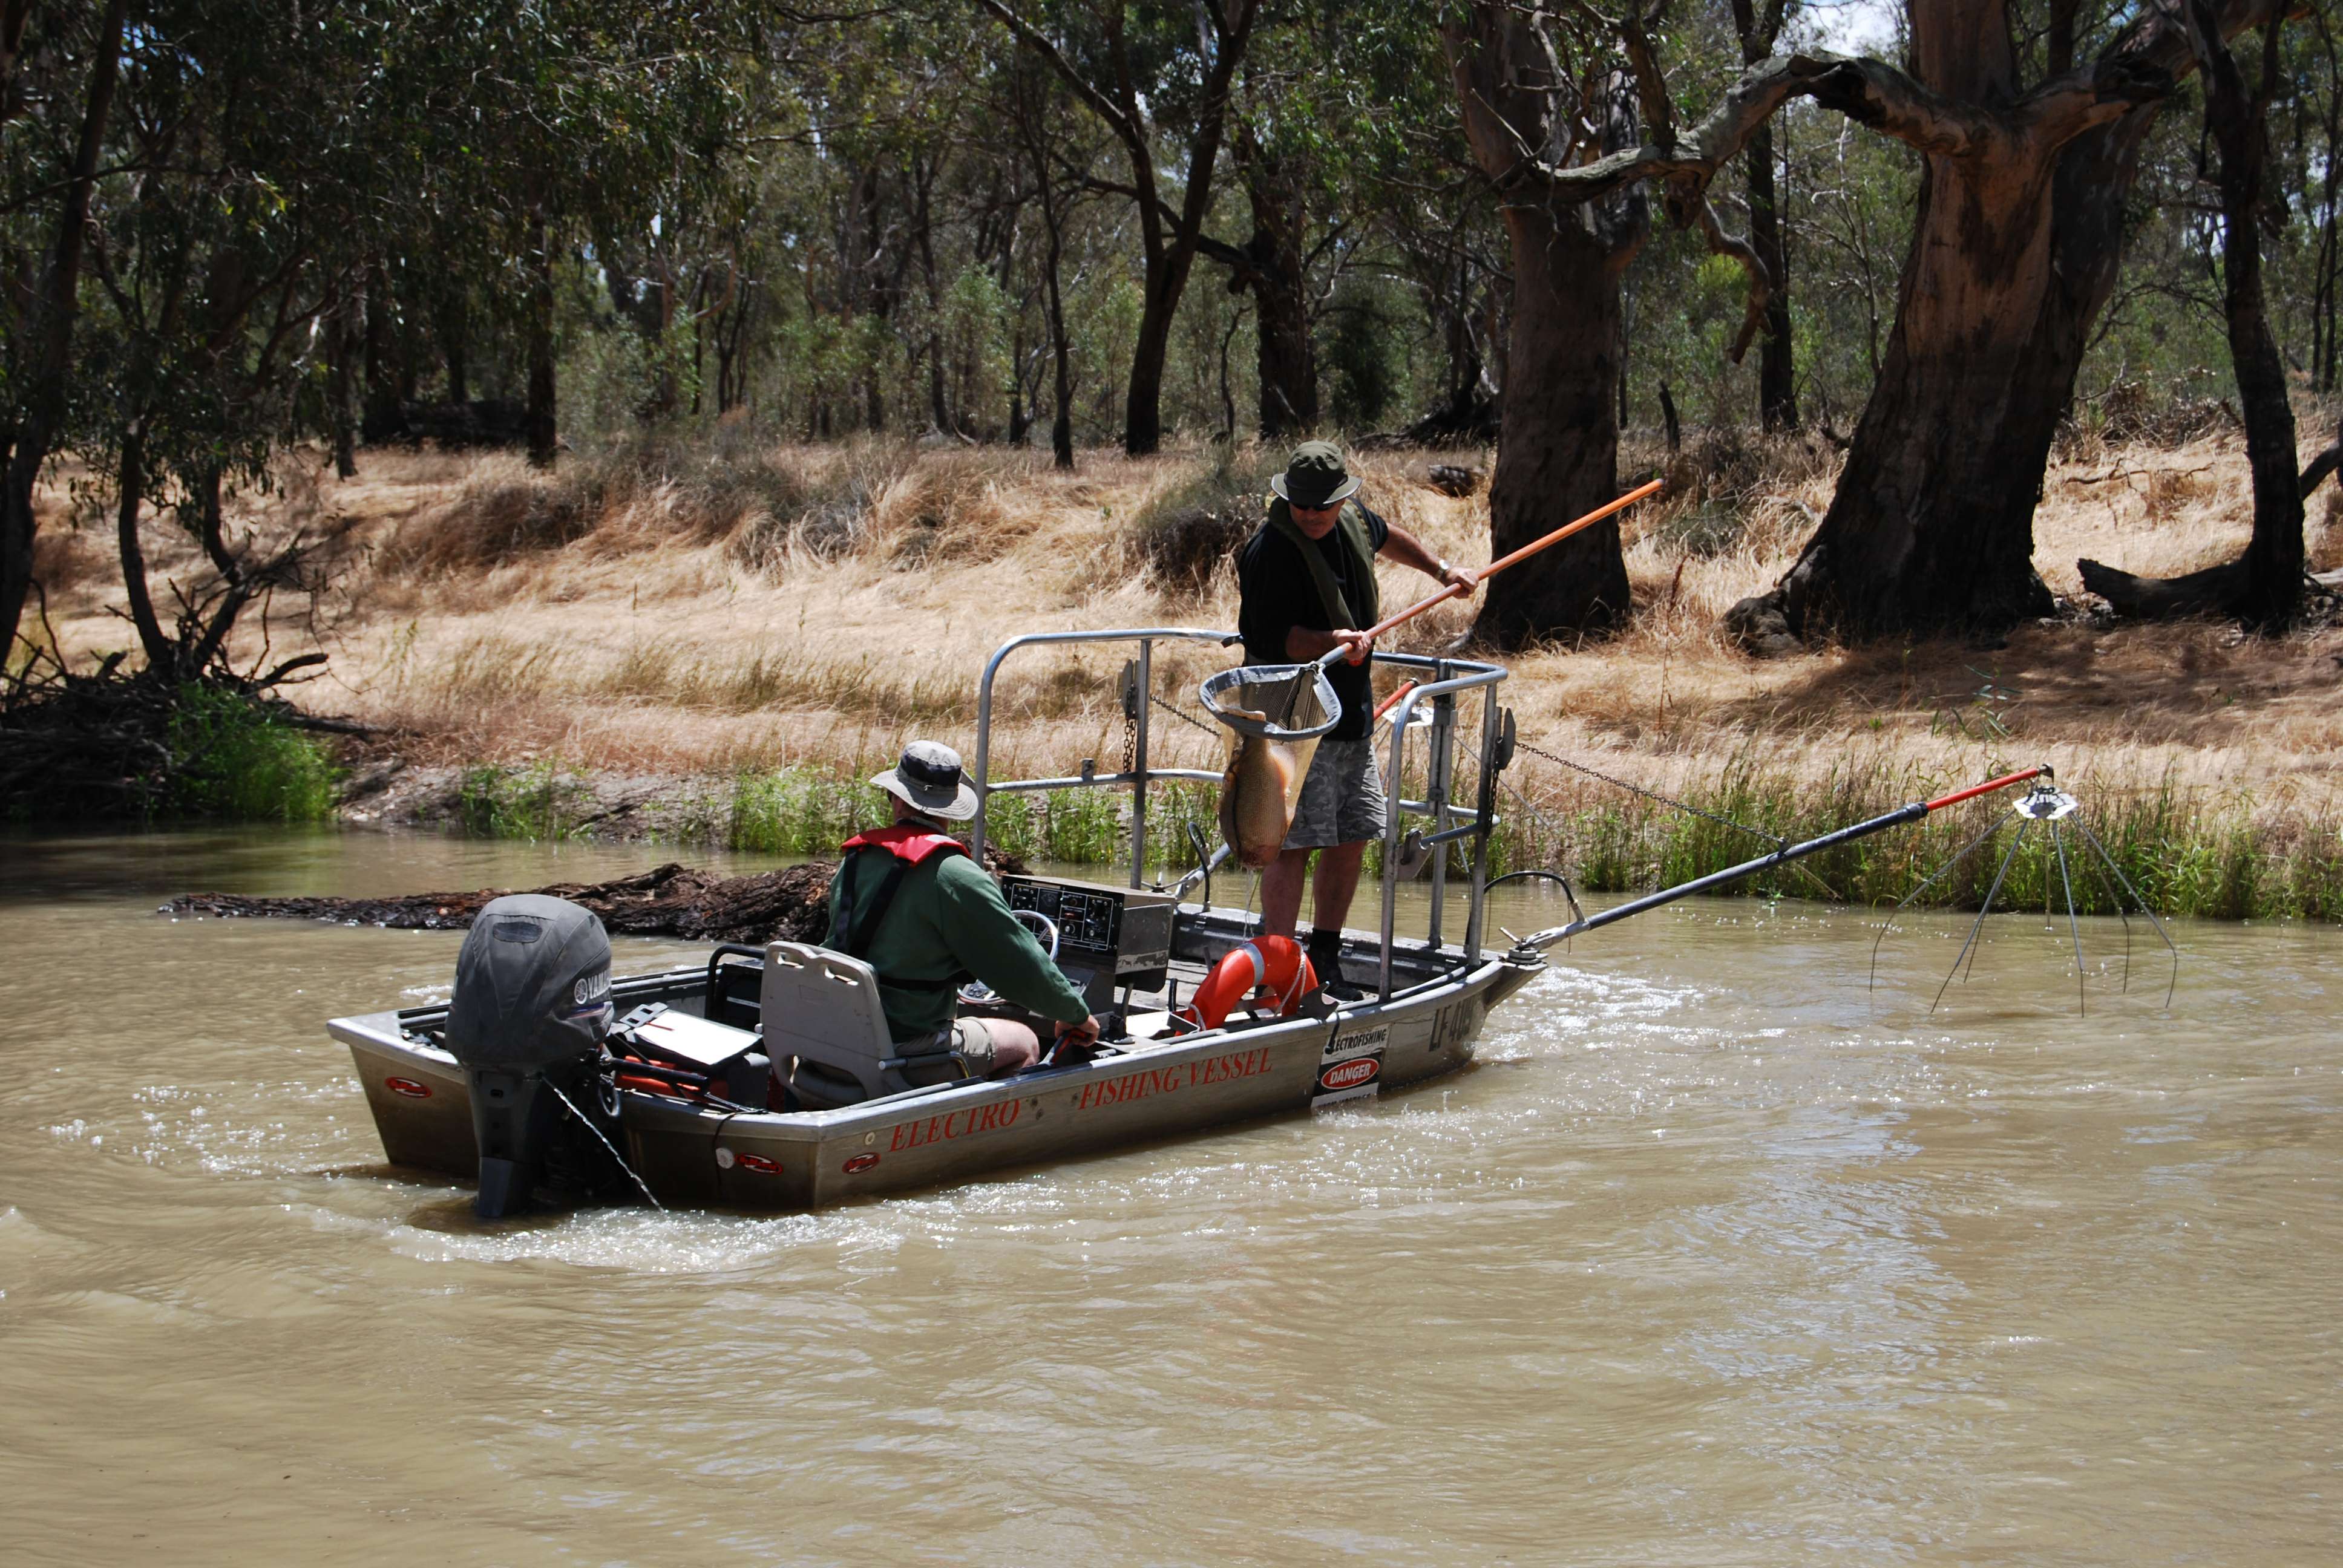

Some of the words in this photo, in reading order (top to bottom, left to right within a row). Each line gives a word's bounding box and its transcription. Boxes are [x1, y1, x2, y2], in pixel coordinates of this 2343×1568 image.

[888, 1099, 1020, 1152] ELECTRO
[1078, 1064, 1184, 1110] FISHING
[1190, 1048, 1273, 1087] VESSEL
[1329, 1063, 1371, 1084] DANGER
